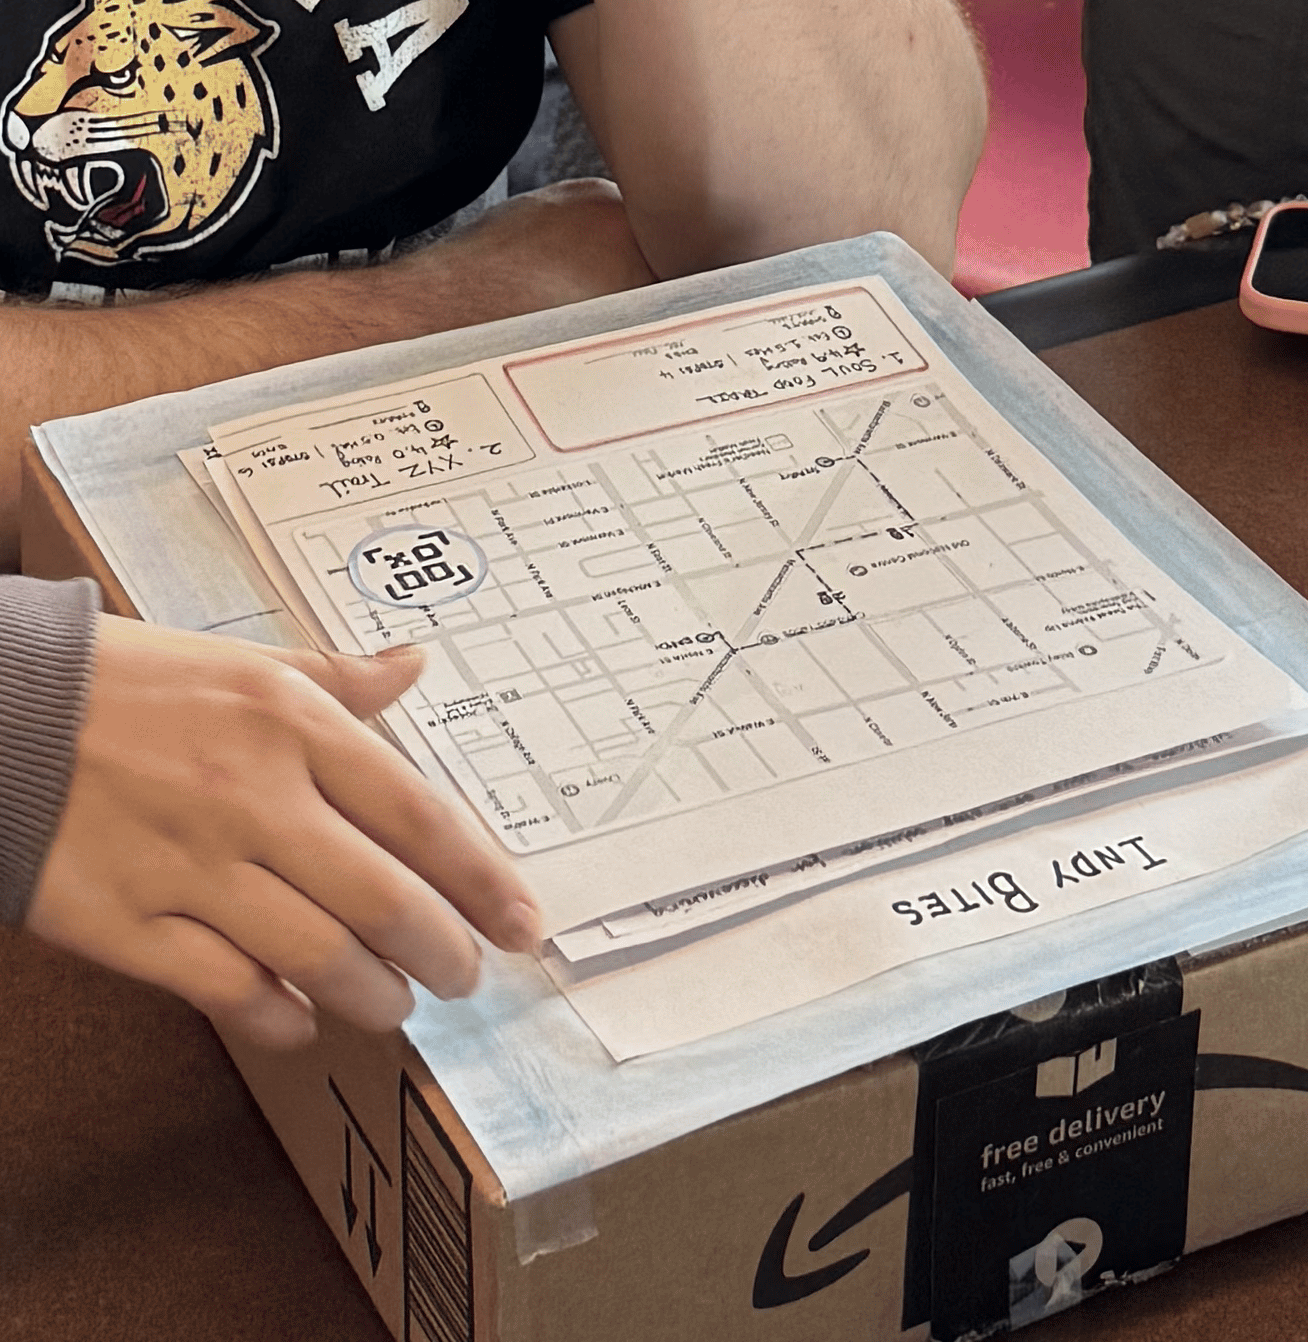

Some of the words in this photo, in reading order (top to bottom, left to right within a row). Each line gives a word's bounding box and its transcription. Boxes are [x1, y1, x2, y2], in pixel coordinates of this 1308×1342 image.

[821, 359, 877, 376] SOUL
[773, 375, 816, 389] FOOD
[696, 389, 768, 403] TRAIL
[398, 454, 463, 478] XYZ
[319, 473, 391, 498] Trail
[1052, 835, 1167, 888] INDY
[891, 870, 1037, 926] BITES
[981, 1135, 1038, 1169] free
[1049, 1091, 1165, 1145] delivery
[981, 1171, 1016, 1192] fast,
[1022, 1158, 1053, 1177] free
[1075, 1118, 1164, 1159] convenient
